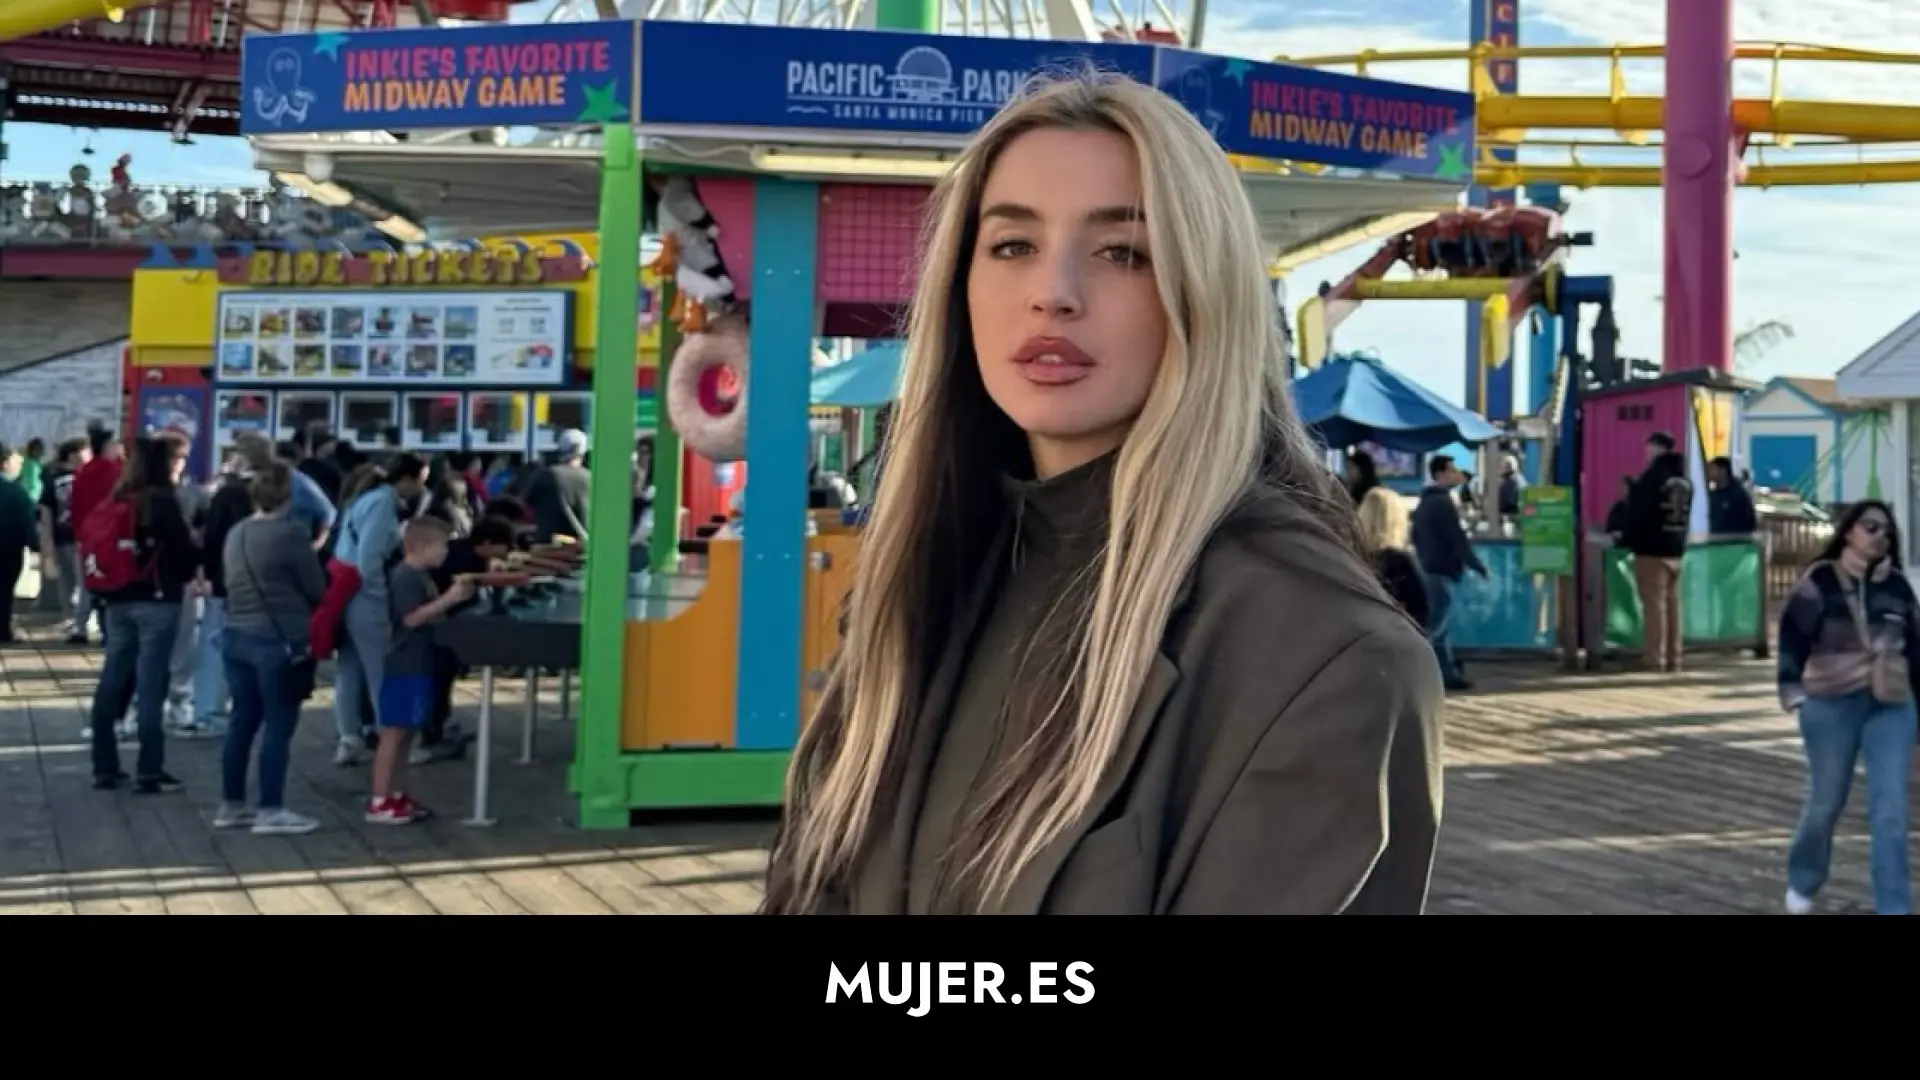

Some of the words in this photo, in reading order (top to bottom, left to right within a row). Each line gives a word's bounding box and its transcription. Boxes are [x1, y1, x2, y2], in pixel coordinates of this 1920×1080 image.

[345, 47, 457, 79] INKIE'S
[465, 41, 611, 75] FAVORITE
[786, 60, 885, 97] PACIFIC
[343, 78, 471, 112] MIDWAY
[477, 75, 566, 108] GAME
[1251, 80, 1344, 118] INKIE'S
[1350, 93, 1460, 135] FAVORITE
[833, 103, 881, 119] SANTA
[887, 106, 944, 123] MONICA
[950, 108, 985, 124] PIER
[1249, 109, 1356, 149] MIDWAY
[1360, 124, 1428, 159] GAME
[248, 249, 346, 284] RIDE
[369, 247, 548, 285] TICKETS
